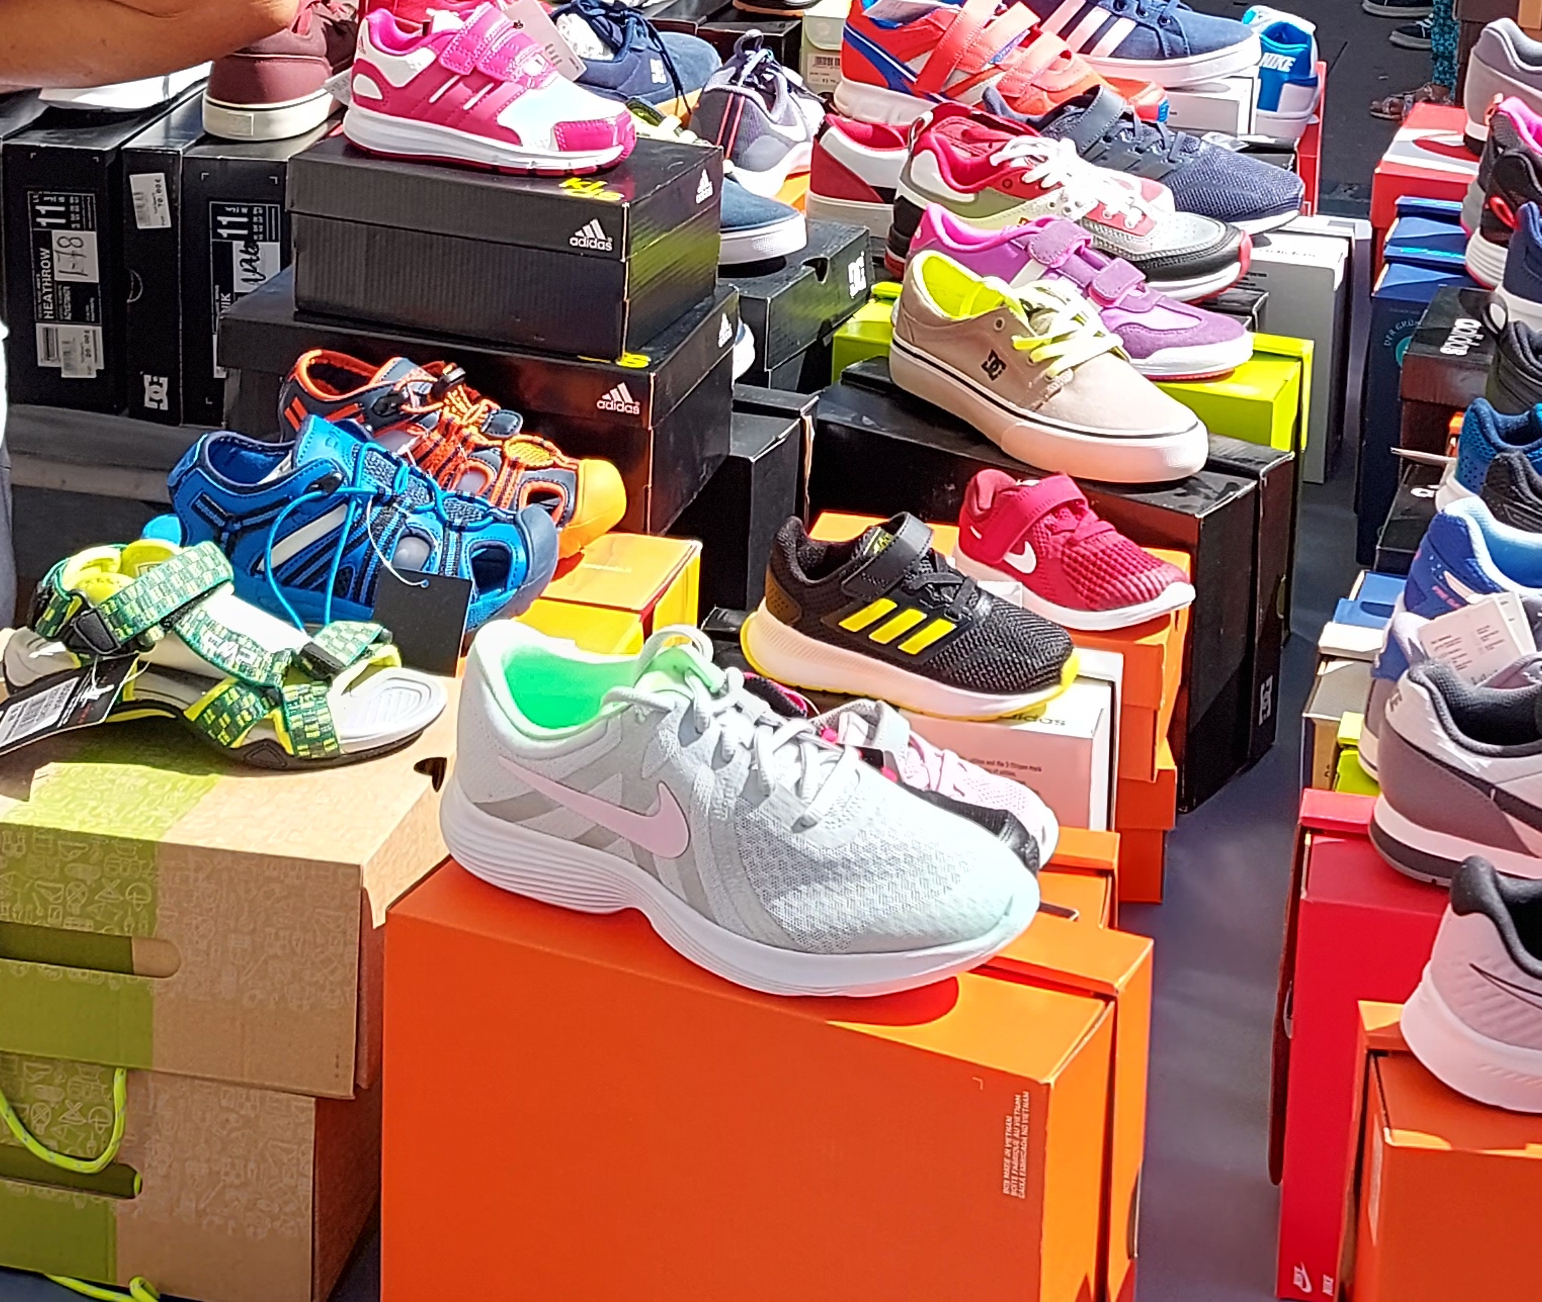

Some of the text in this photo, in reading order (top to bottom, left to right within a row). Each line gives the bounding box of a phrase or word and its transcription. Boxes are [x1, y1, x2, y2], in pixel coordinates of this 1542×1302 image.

[1259, 52, 1296, 73] NIKE
[35, 205, 66, 228] 11
[217, 216, 249, 239] 11
[569, 236, 613, 251] adidas
[40, 247, 55, 320] HEATHROW
[1439, 318, 1485, 356] adidas
[596, 399, 640, 414] adidas
